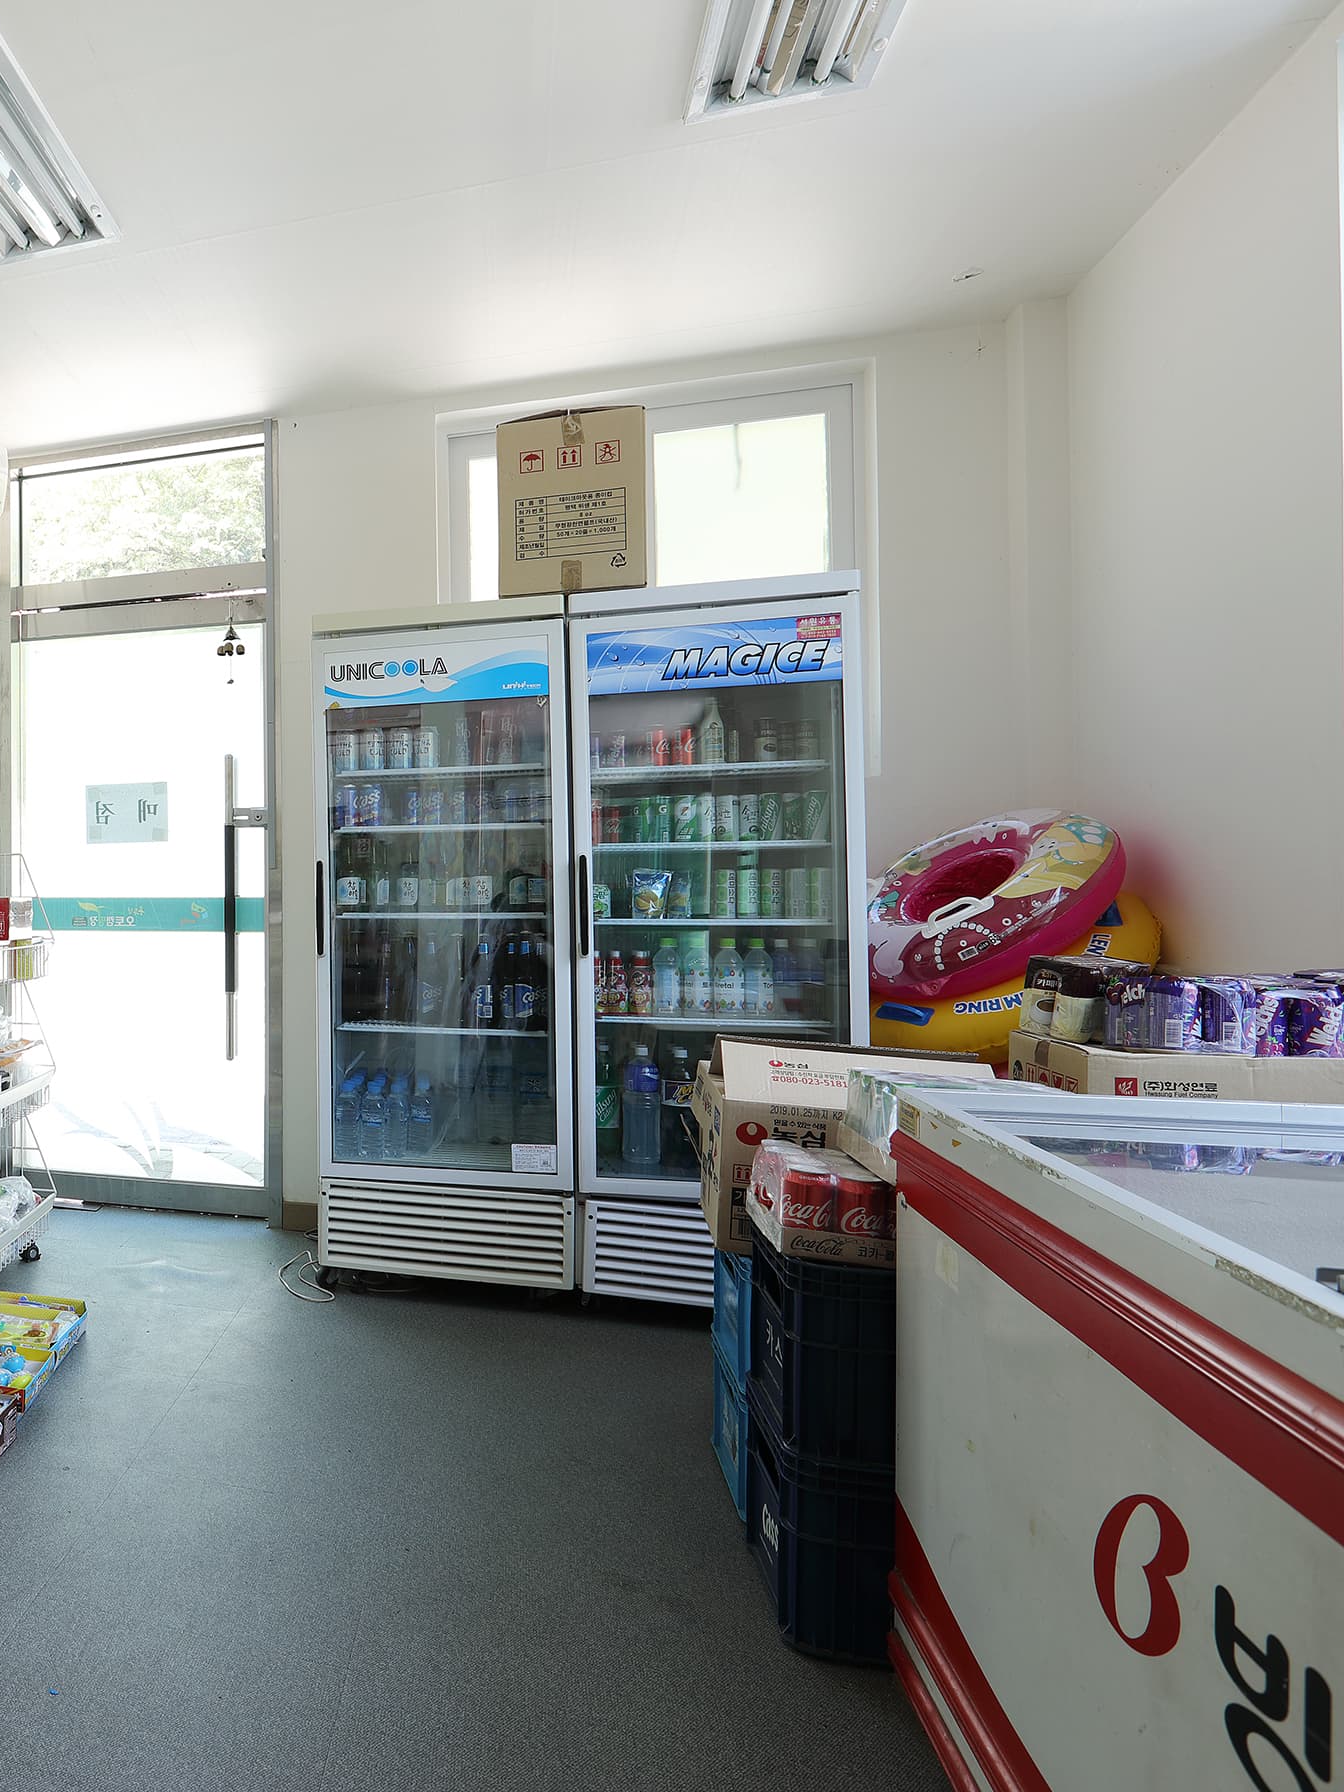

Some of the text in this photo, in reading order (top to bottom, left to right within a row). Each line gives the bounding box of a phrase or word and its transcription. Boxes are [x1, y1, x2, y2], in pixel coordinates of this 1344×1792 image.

[330, 657, 449, 683] UNICOOLA
[661, 640, 831, 681] MAGICE
[953, 996, 1003, 1015] RING
[779, 1076, 848, 1088] 080-023-5181
[1143, 1081, 1218, 1093] (주)화성연료
[1189, 1092, 1219, 1100] Company
[769, 1105, 844, 1121] 2019.01.25까지 K2
[791, 1235, 844, 1257] Coca-Cola
[761, 1503, 779, 1552] Cass
